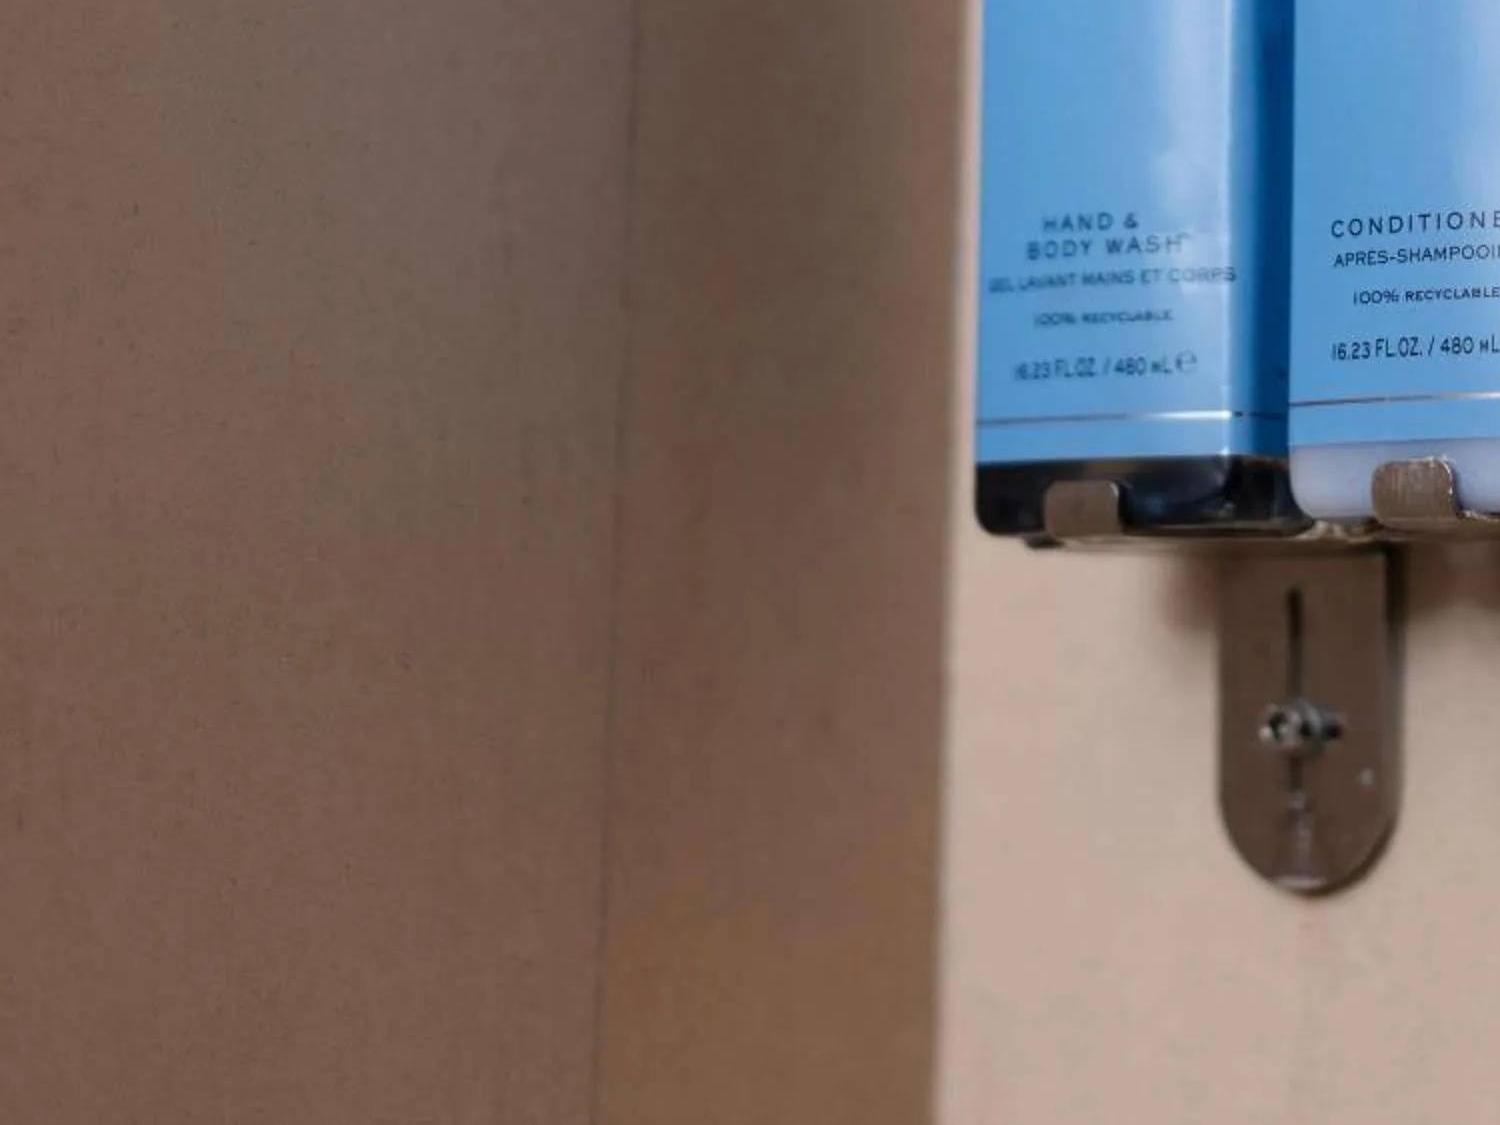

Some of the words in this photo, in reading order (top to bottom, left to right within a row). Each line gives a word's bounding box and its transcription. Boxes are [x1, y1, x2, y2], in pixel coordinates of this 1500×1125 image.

[1042, 211, 1114, 232] HAND
[1123, 212, 1140, 230] &
[1026, 238, 1093, 261] BODY
[1105, 233, 1187, 255] WASH
[1140, 267, 1163, 284] ET
[1353, 287, 1400, 305] 100%
[1405, 286, 1500, 303] RECYCLABLE
[1332, 341, 1371, 361] 16.23
[1440, 336, 1475, 356] 480
